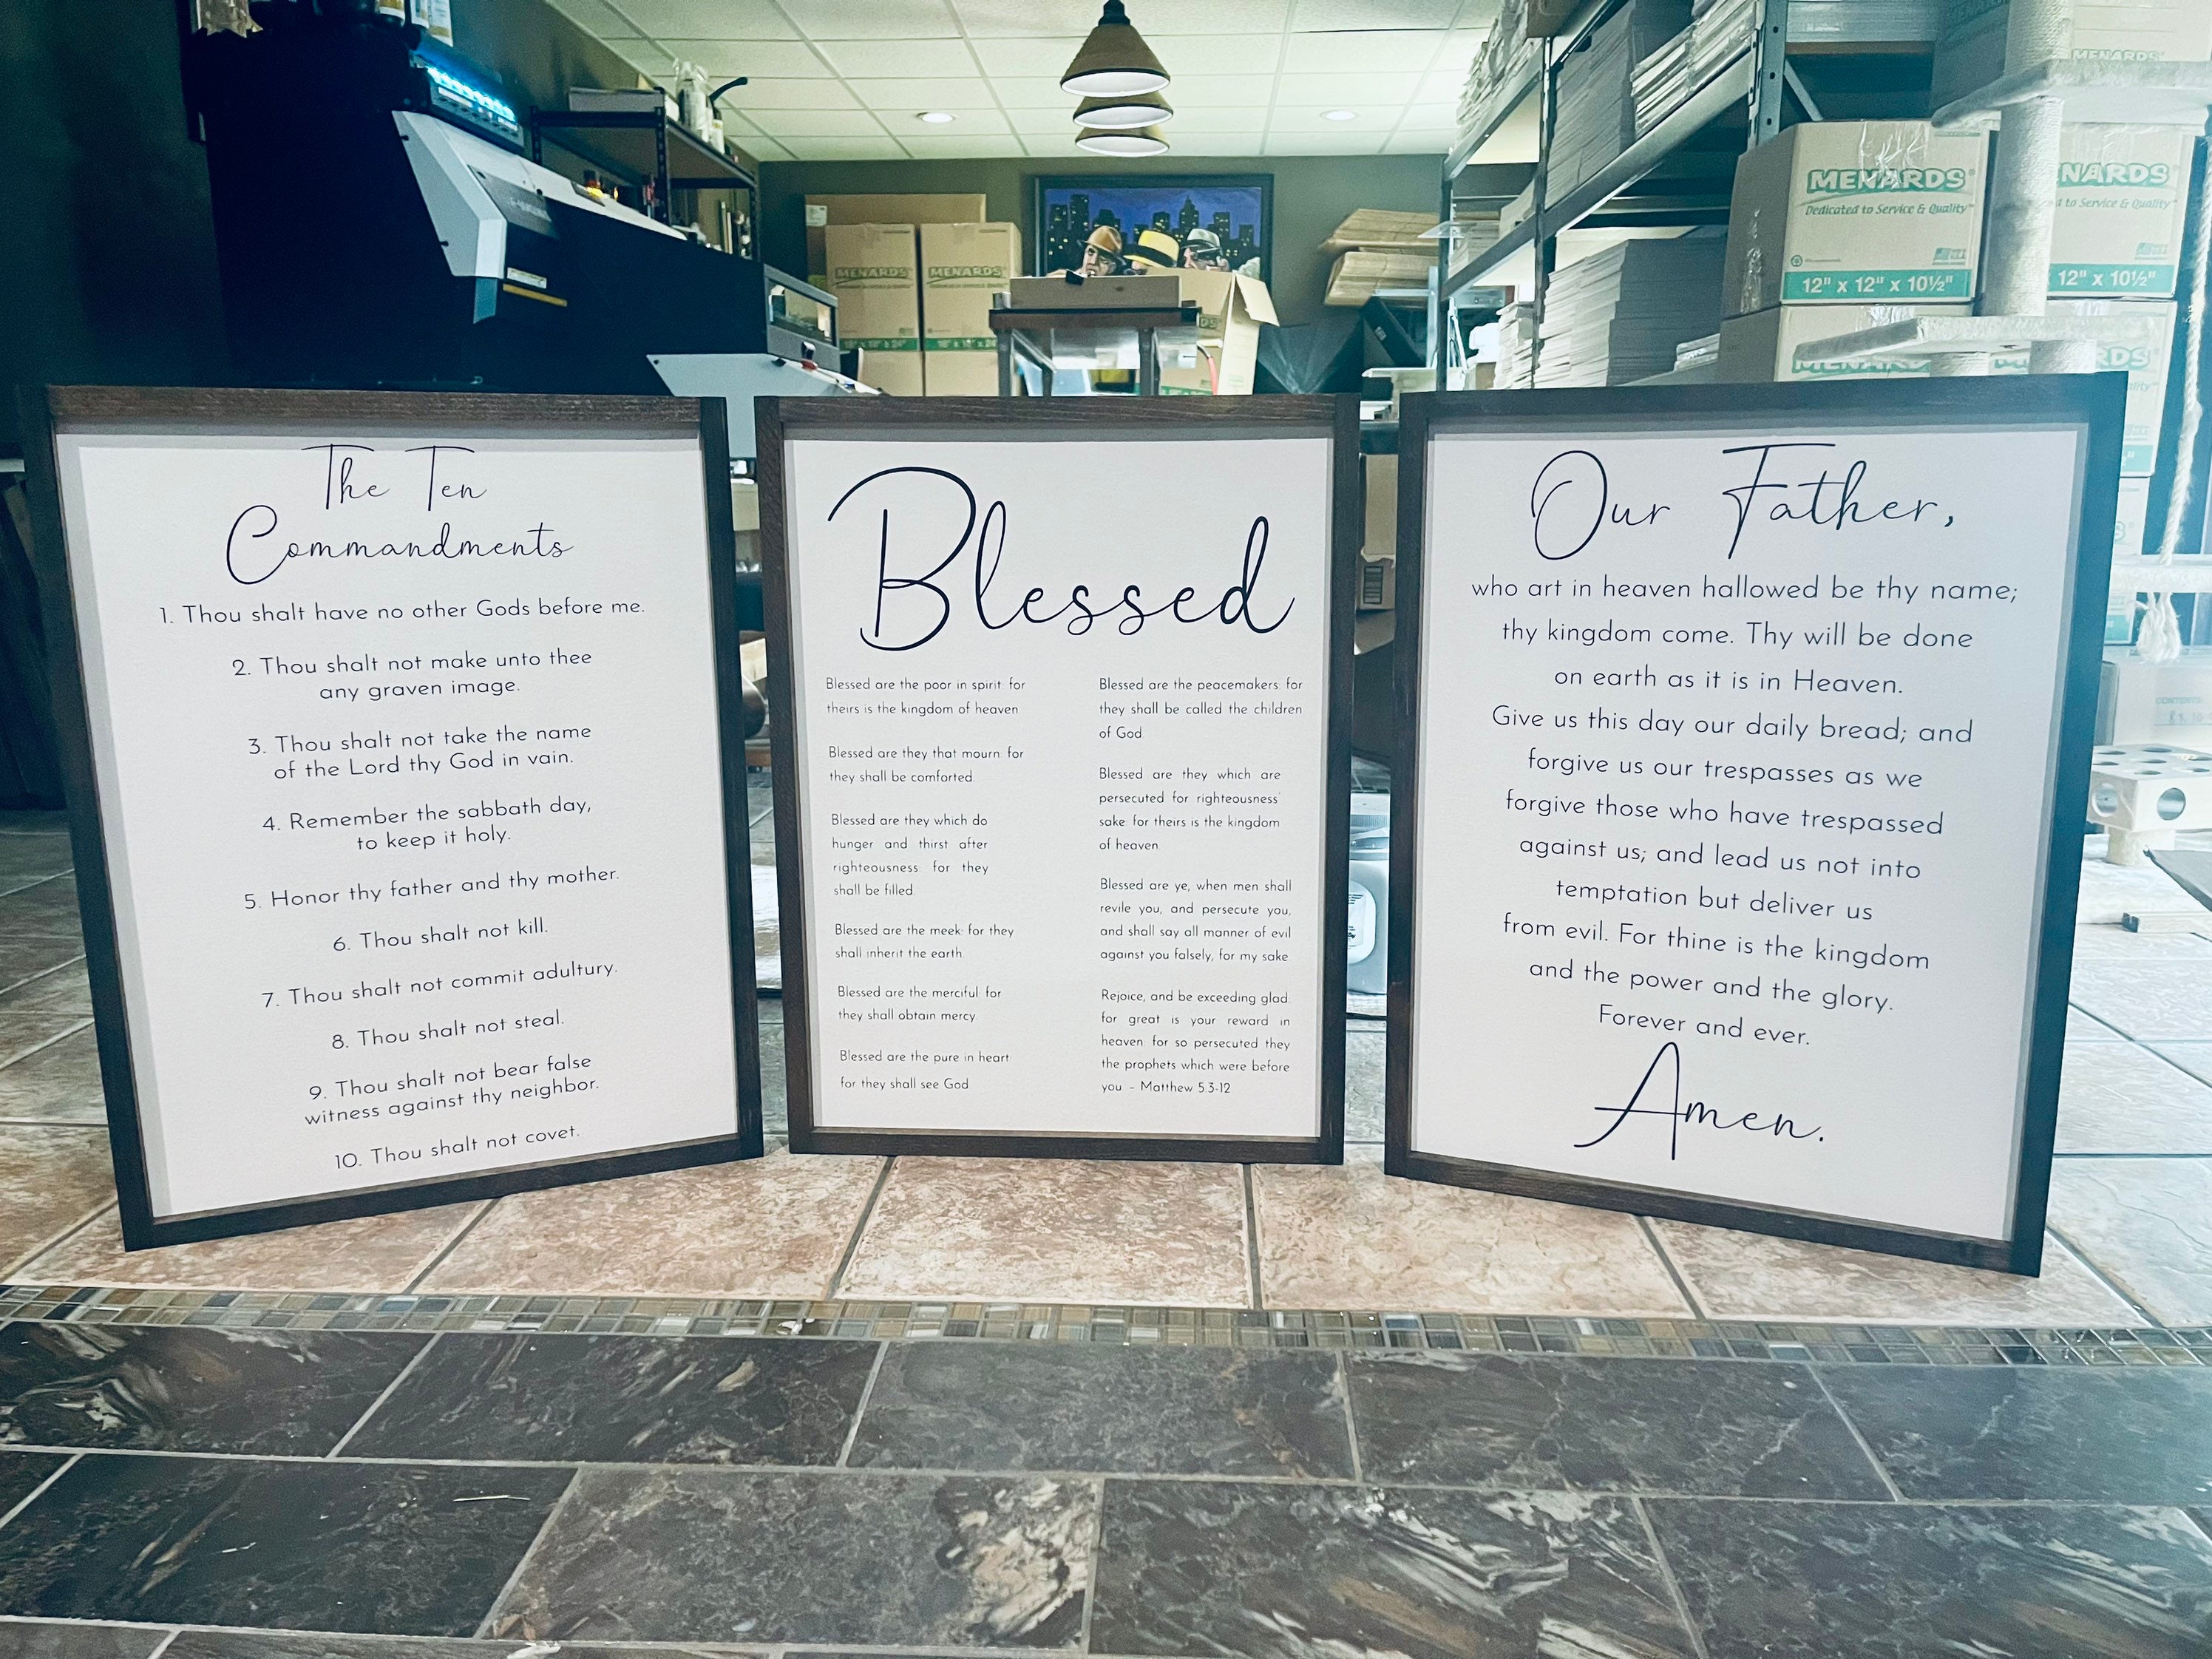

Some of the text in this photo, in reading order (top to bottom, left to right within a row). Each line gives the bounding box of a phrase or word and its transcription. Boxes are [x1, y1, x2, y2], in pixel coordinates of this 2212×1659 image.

[1806, 167, 1967, 194] MENARDS
[2058, 162, 2171, 188] NARDS
[1805, 203, 1968, 216] Dedicated to Service & Quality
[2079, 197, 2118, 208] Service
[2131, 198, 2171, 210] Quality
[301, 443, 488, 512] The Ten
[1530, 441, 1955, 562] Our Father,
[225, 503, 574, 586] Commandments
[826, 465, 1296, 652] Blessed
[1471, 573, 2018, 605] who art in heaven hallowed be thy name;
[159, 596, 645, 624] 1. Thou shalt have no other Gods before me.
[1502, 617, 1973, 650] thy kingdom come. Thy will be done
[319, 680, 520, 702] any graven image.
[1554, 663, 1903, 693] on earth as it is in Heaven.
[827, 700, 1018, 717] theirs is the kingdom of heaven
[1099, 701, 1302, 717] they shall be called the children
[274, 750, 573, 779] of the Lord thy God in vain.
[1099, 766, 1281, 782] Blessed are they which are
[262, 795, 591, 831] 4. Remember the sabbath day,
[1506, 788, 1944, 835] forgive those who have trespassed
[357, 824, 511, 850] to keep it holy.
[832, 836, 988, 852] hunger and thirst after
[1556, 880, 1873, 920] temptation but deliver us
[1100, 923, 1291, 939] and shall say all manner of evil
[261, 991, 279, 1008] 7.
[288, 986, 342, 1005] Thou
[352, 978, 401, 999] shalt
[410, 977, 443, 993] not
[451, 969, 525, 988] commit
[1530, 958, 1893, 1014] and the power and the glory.
[1102, 1011, 1290, 1028] for great is your reward in
[1599, 1003, 1810, 1045] Forever and ever.
[1102, 1056, 1290, 1073] the prophets which were before
[304, 1076, 599, 1125] witness against thy neighbor.
[1573, 1040, 1825, 1161] Amen.
